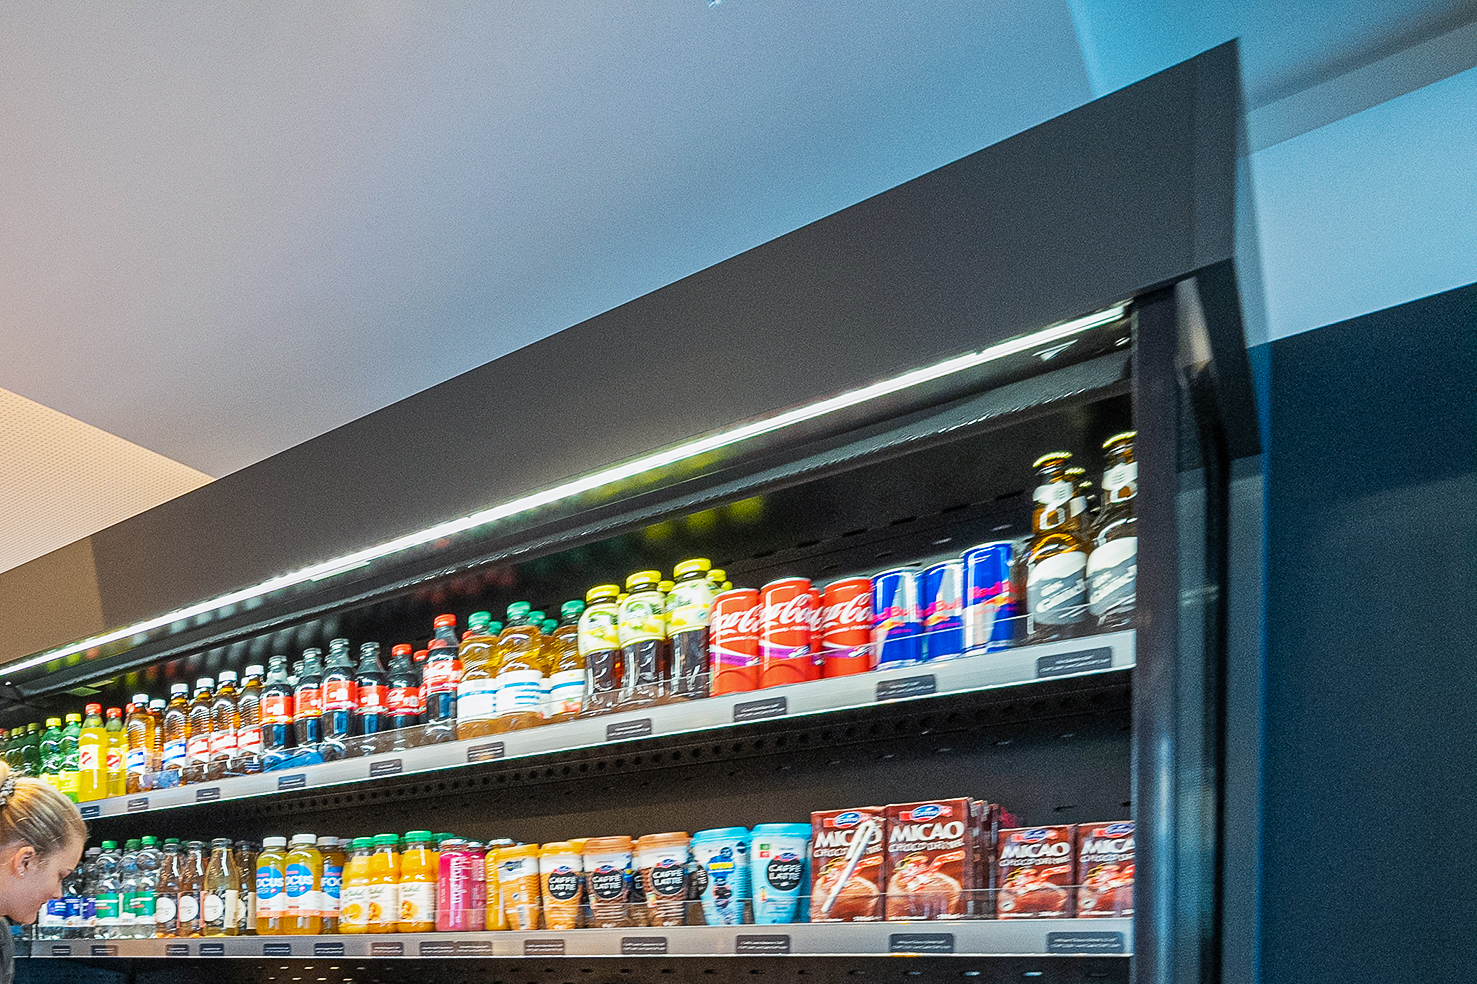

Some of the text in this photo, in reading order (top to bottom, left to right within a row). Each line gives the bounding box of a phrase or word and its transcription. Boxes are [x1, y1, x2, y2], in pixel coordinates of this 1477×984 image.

[814, 826, 884, 849] MICO
[889, 821, 965, 844] MICAO
[1000, 842, 1071, 859] MICAO
[1080, 838, 1136, 855] MICA
[256, 877, 284, 888] OCUS
